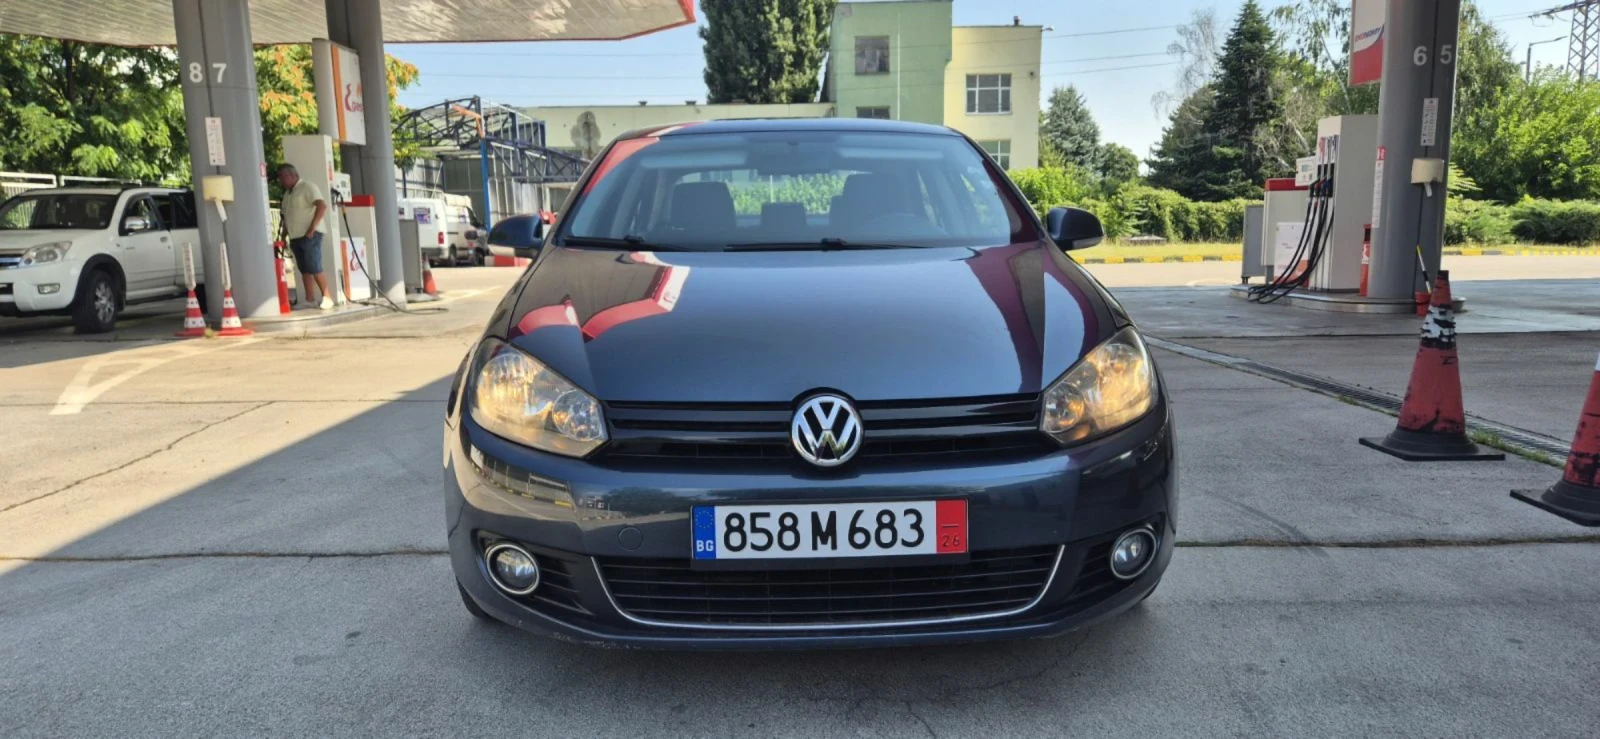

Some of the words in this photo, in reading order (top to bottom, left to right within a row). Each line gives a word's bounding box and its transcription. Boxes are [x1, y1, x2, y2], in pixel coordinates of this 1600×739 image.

[1413, 45, 1428, 66] 6
[1440, 44, 1452, 65] 5
[189, 62, 203, 83] 8
[212, 63, 227, 83] 7
[793, 396, 861, 465] VW
[723, 512, 801, 552] 858
[811, 510, 838, 551] M
[848, 508, 925, 550] 683
[942, 534, 960, 547] 26
[696, 539, 714, 552] BG
